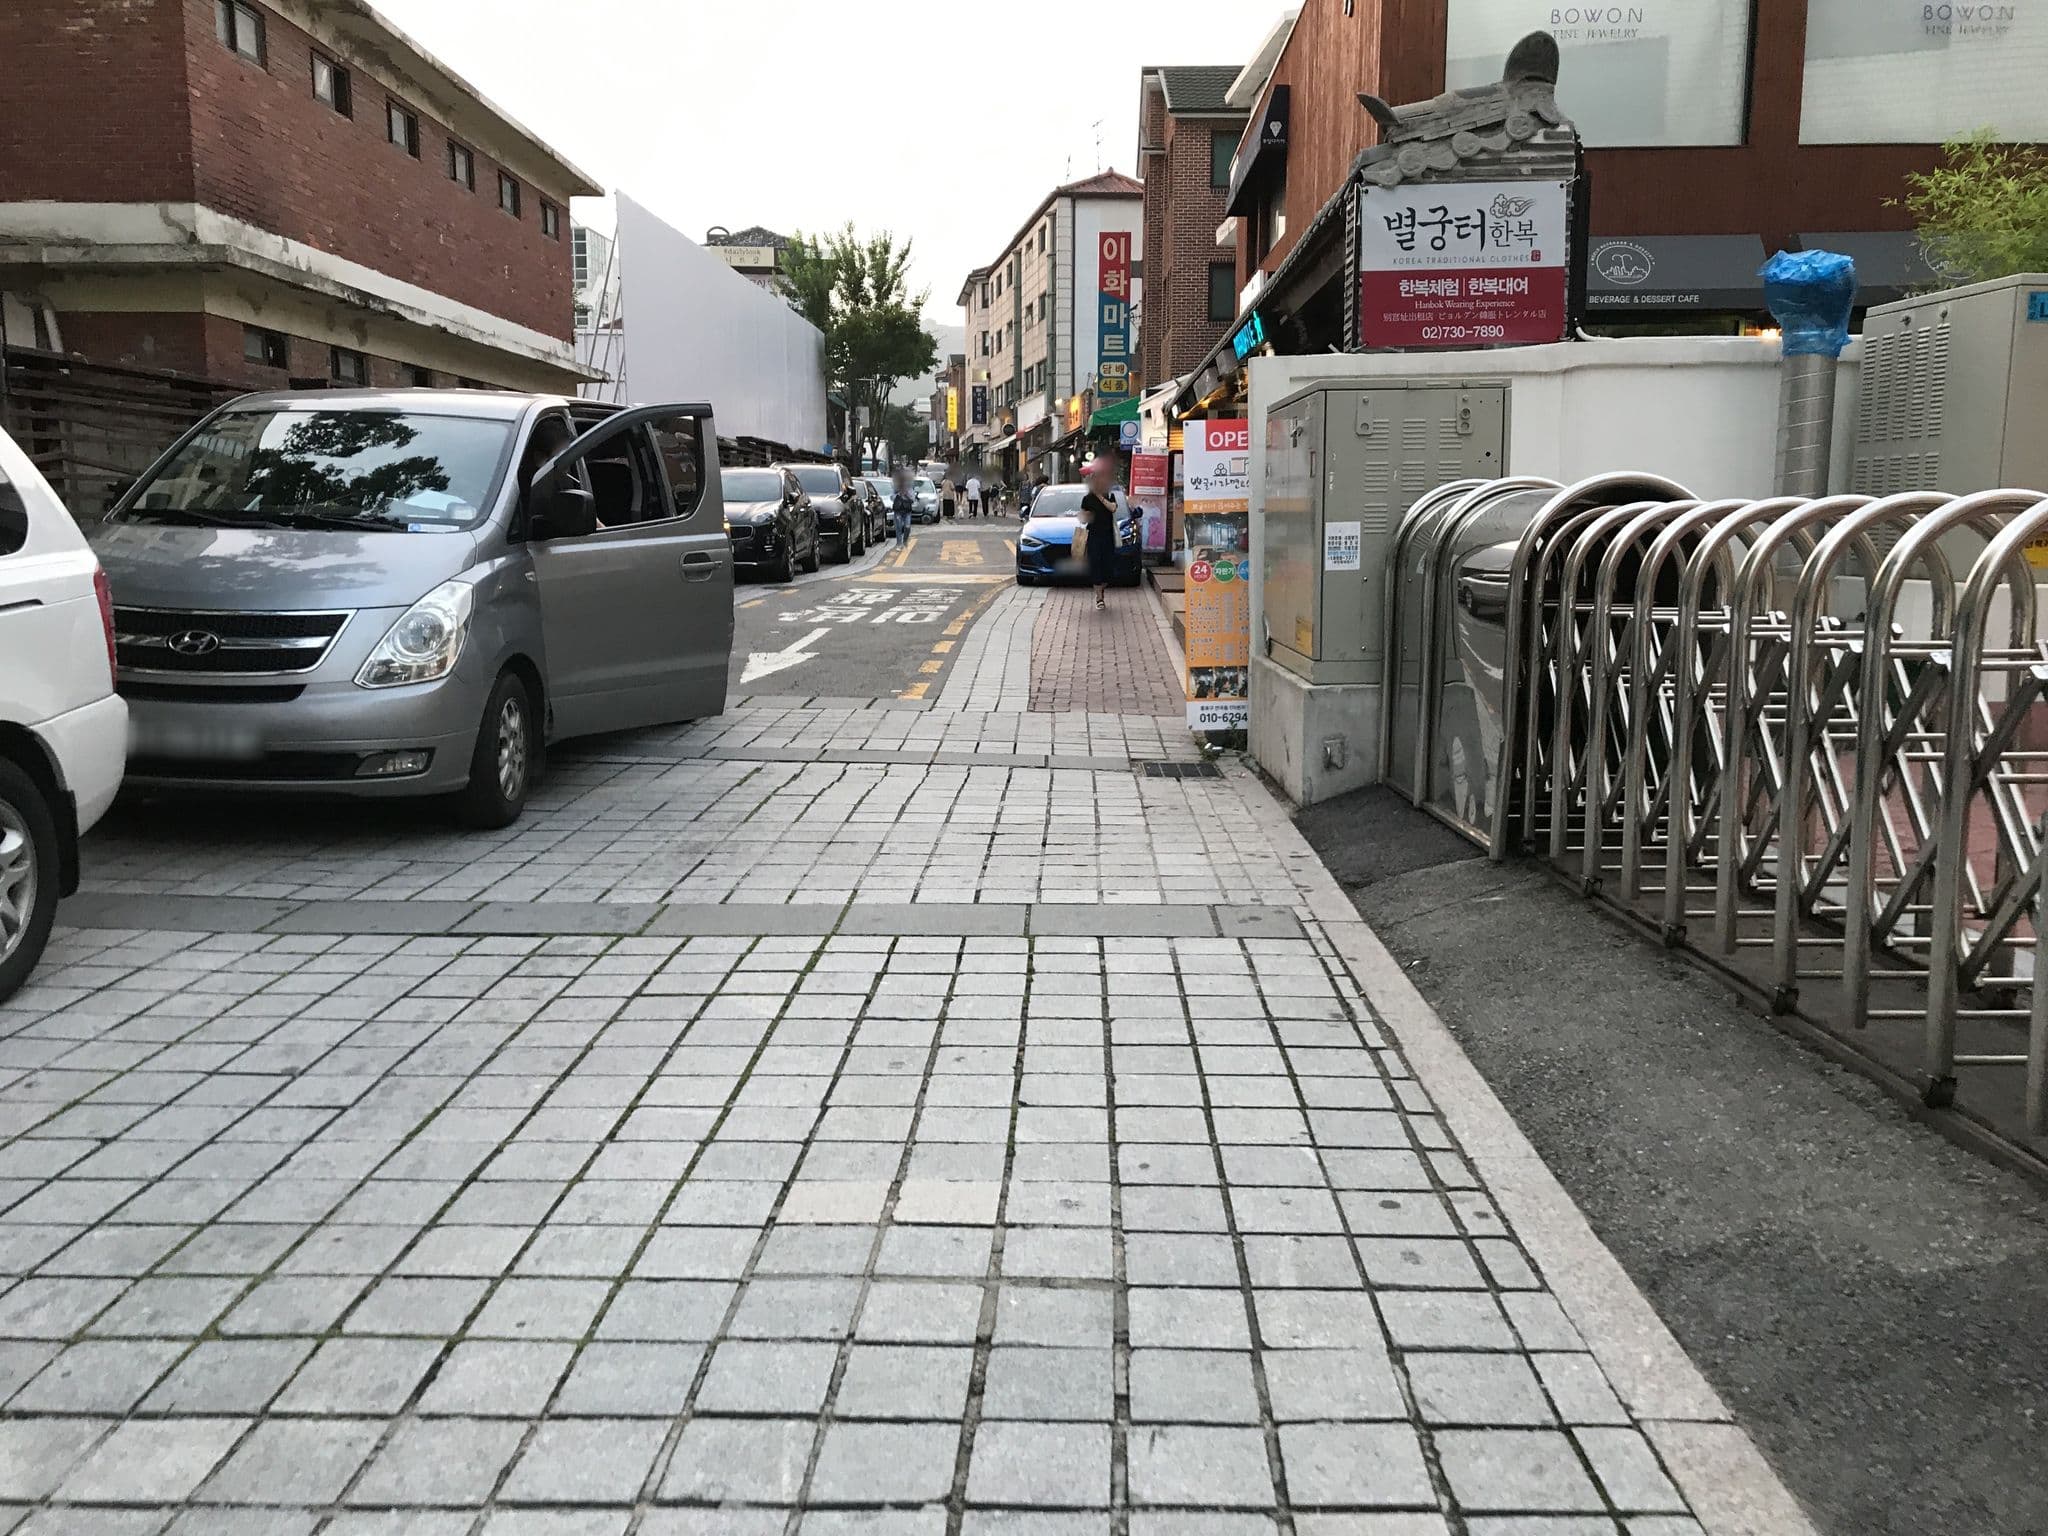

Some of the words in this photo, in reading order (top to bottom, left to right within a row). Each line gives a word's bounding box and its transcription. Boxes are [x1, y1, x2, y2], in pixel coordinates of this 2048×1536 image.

[1551, 8, 1642, 24] BOWON
[1924, 5, 2014, 20] BOWON
[1553, 29, 1579, 39] FINE
[1383, 205, 1486, 251] 별궁터
[1489, 219, 1538, 248] 한복
[1393, 256, 1422, 265] KOREA
[1426, 255, 1485, 264] TRADITIONAL
[1490, 254, 1529, 263] CLOTHES
[1399, 278, 1459, 297] 한복체험
[1468, 276, 1529, 296] 한복대여
[1101, 237, 1128, 356] 이화마트
[1589, 295, 1631, 304] BEVERAGE
[1633, 295, 1639, 303] &
[1641, 294, 1676, 303] DESSERT
[1678, 294, 1700, 303] CAFE
[1415, 300, 1443, 309] Hanbok
[1444, 300, 1475, 311] Wearing
[1476, 299, 1515, 310] Experience
[1422, 325, 1505, 339] 02)730-7890
[1194, 564, 1208, 574] 24
[1200, 712, 1248, 723] 010-6294
